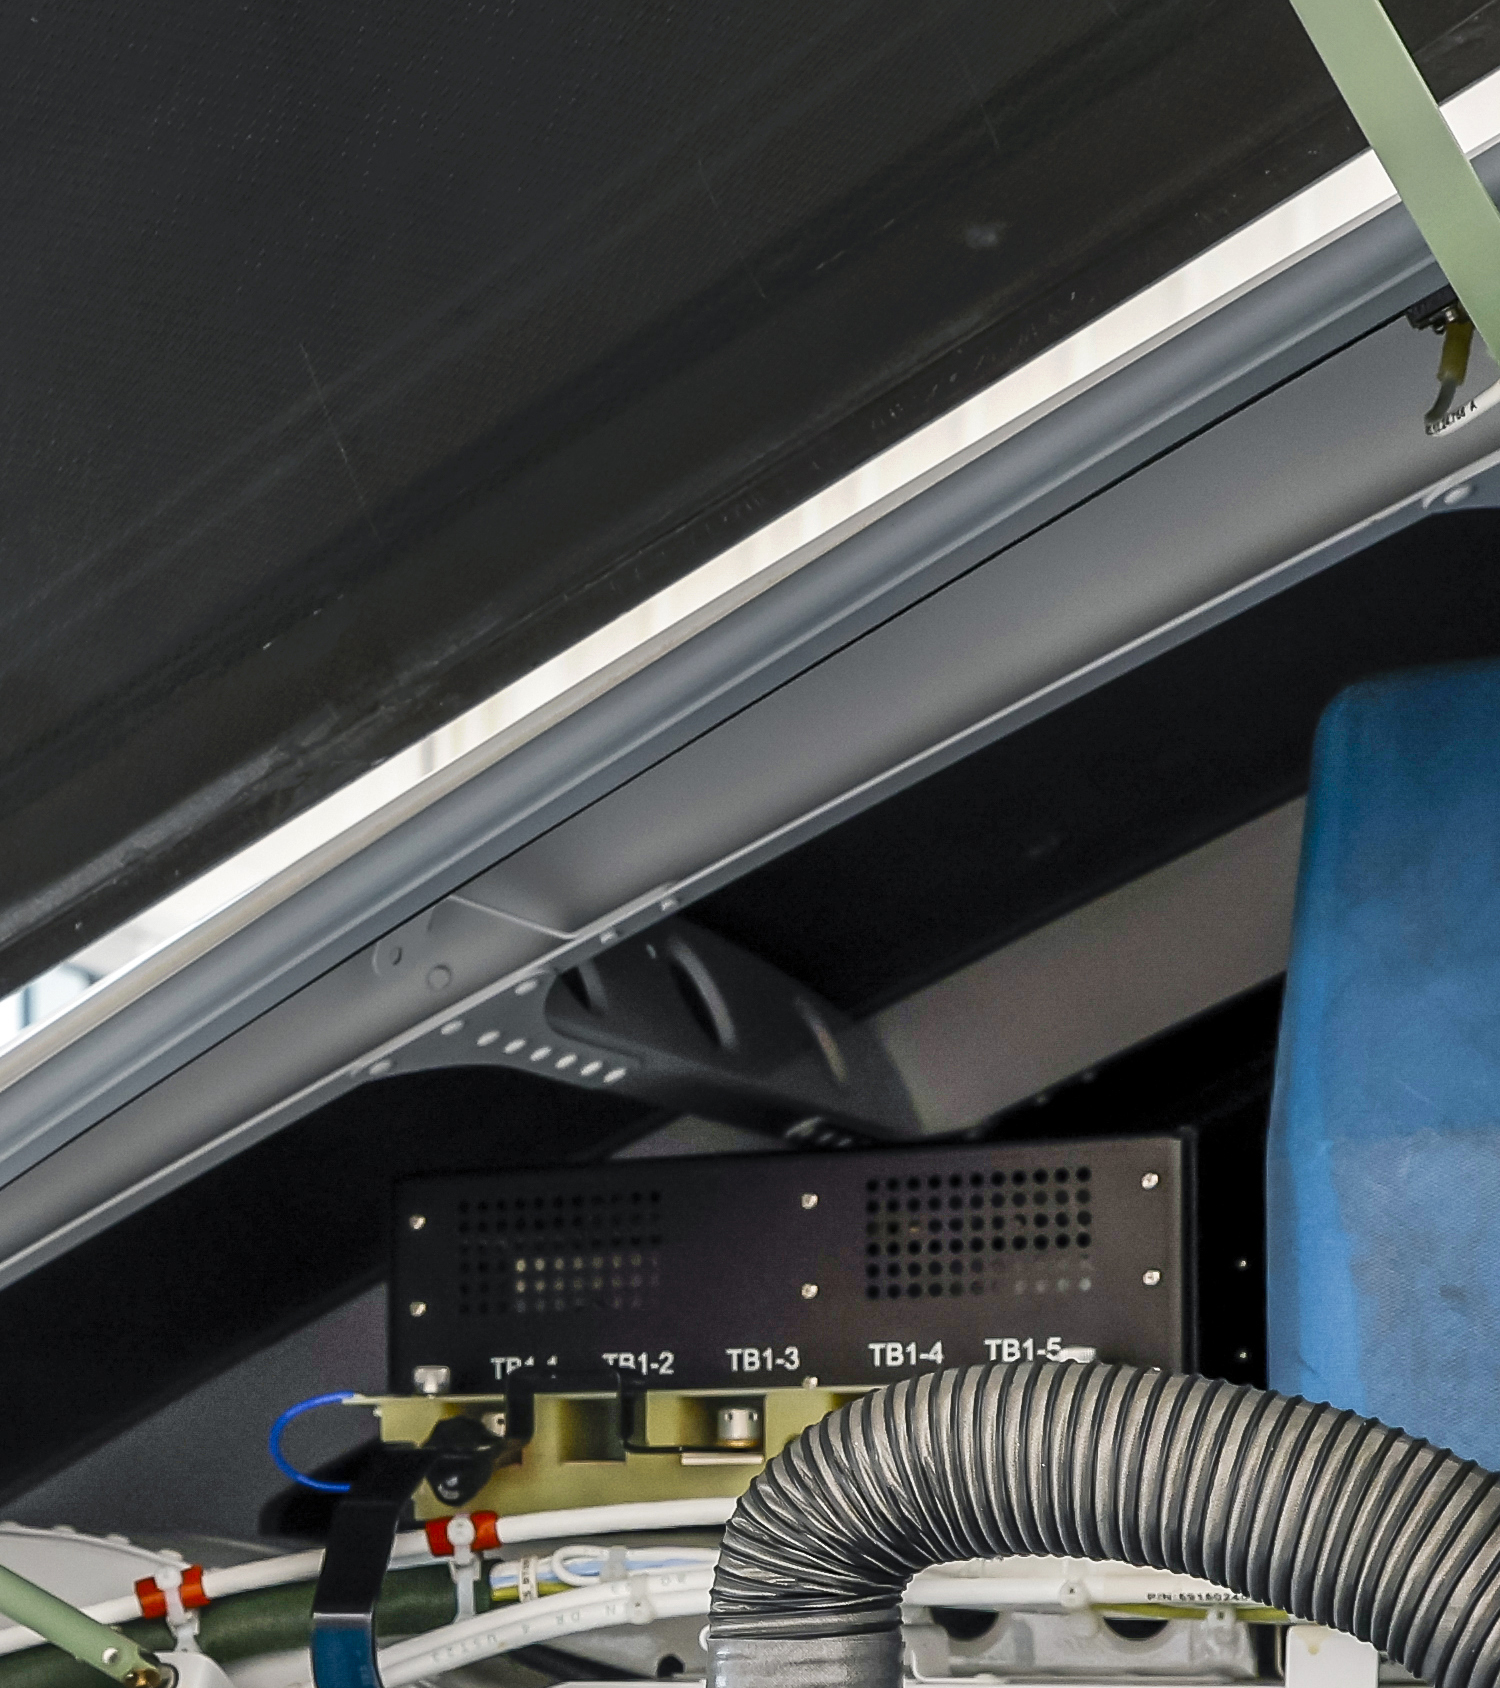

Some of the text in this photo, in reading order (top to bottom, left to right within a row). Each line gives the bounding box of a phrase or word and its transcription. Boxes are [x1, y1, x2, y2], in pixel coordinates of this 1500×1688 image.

[726, 1346, 800, 1373] TB1-3
[868, 1341, 944, 1367] TB1-4
[984, 1337, 1064, 1363] TB1-5
